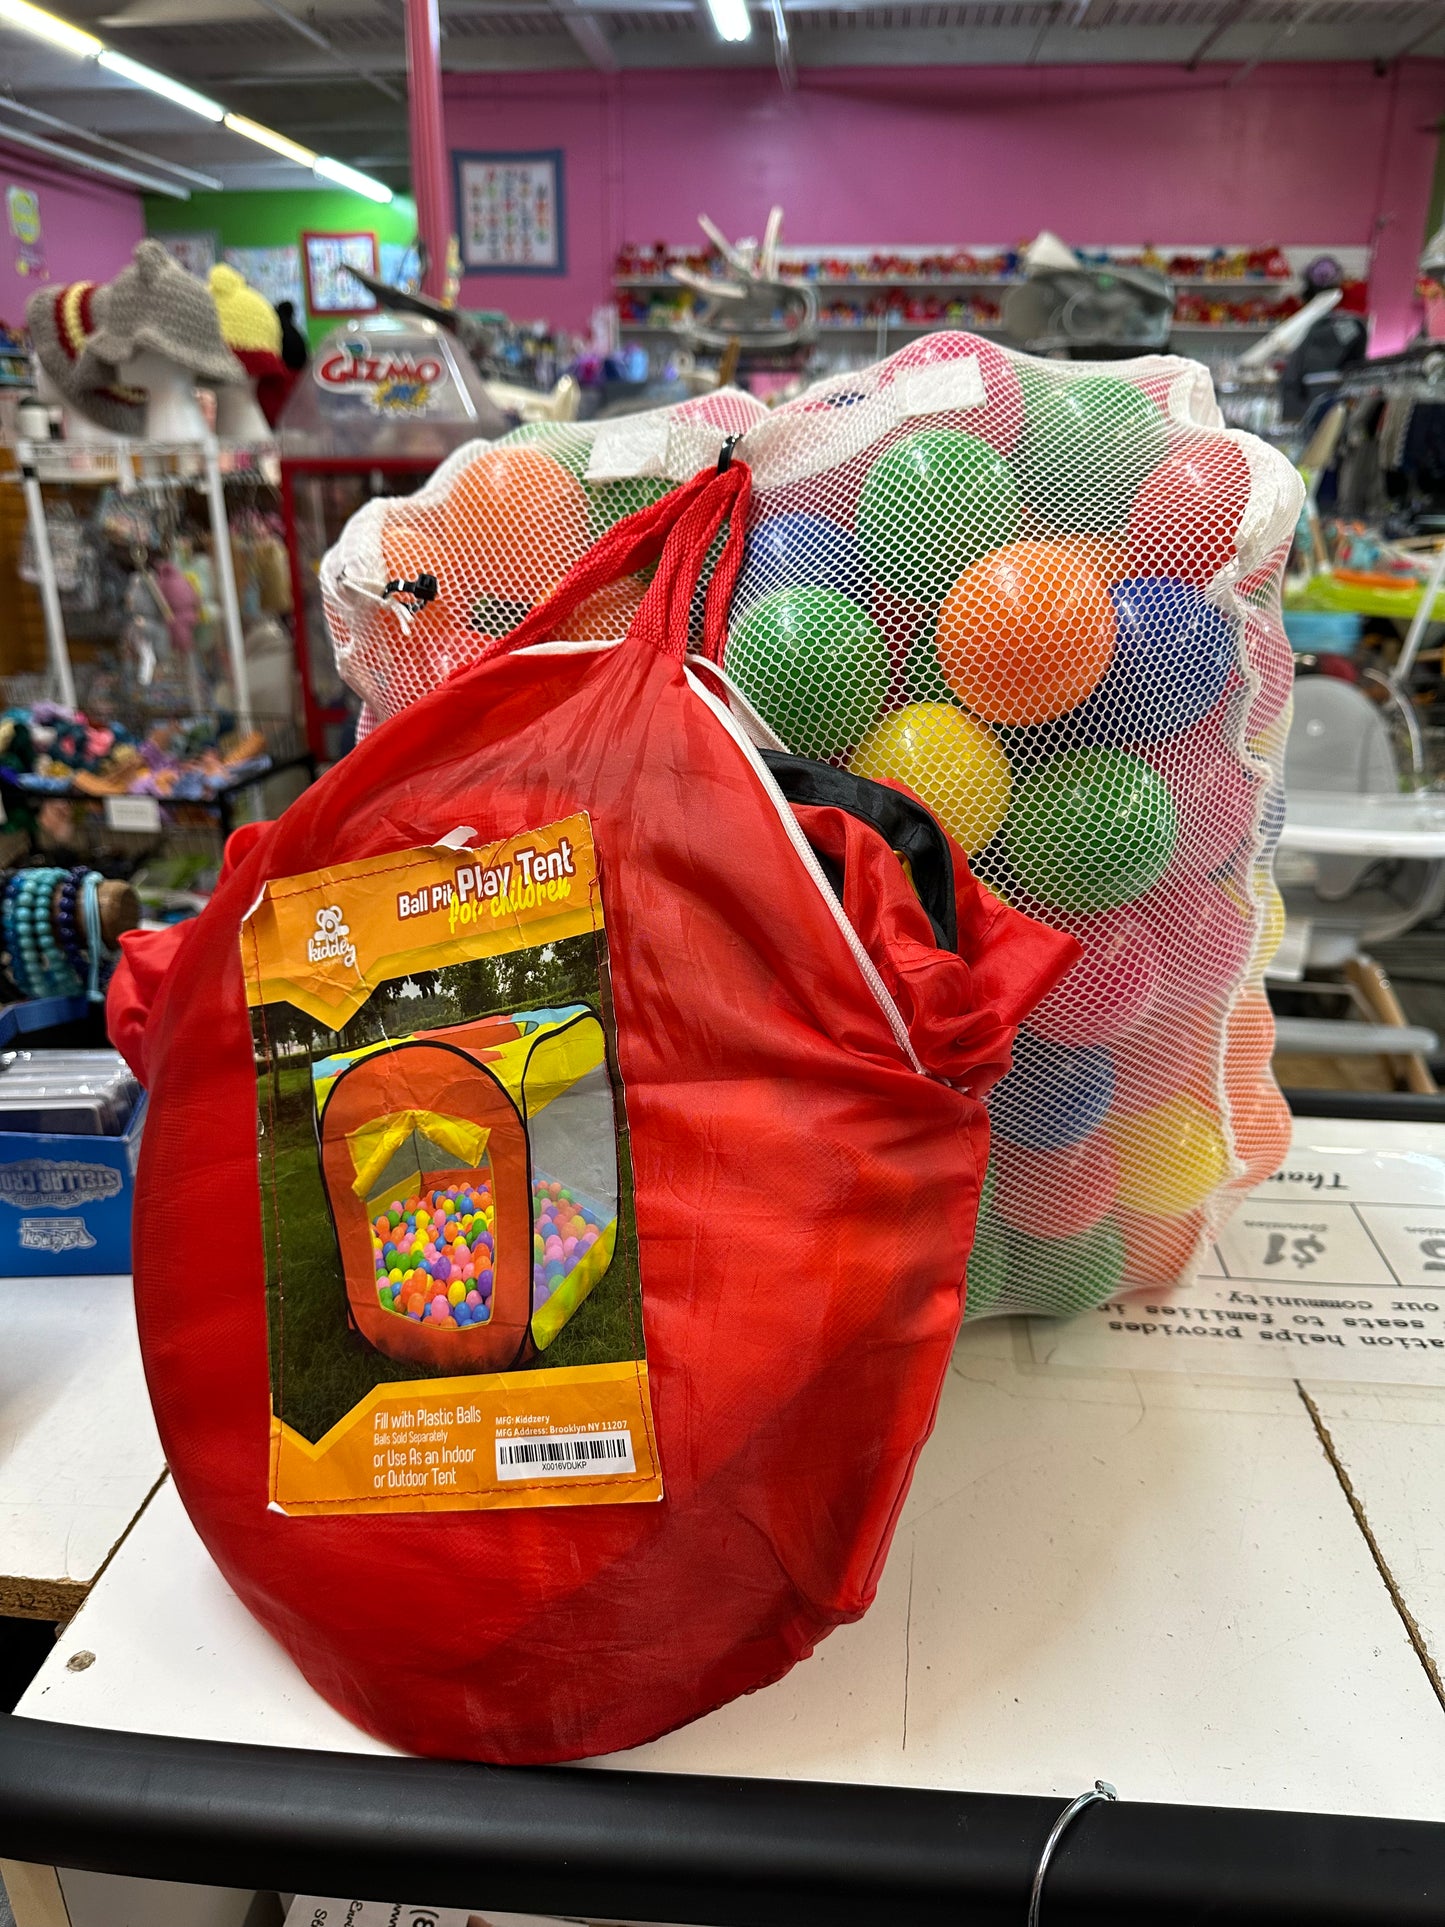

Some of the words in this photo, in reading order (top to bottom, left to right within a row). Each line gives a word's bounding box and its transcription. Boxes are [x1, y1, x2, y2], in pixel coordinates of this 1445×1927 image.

[398, 889, 428, 918] Ball
[432, 883, 453, 909] Pit
[456, 865, 512, 902] Play
[516, 840, 574, 886] Tent
[448, 891, 482, 935] for
[490, 872, 571, 918] children
[40, 1170, 119, 1192] STELLAR
[1262, 1232, 1327, 1270] $1
[1216, 1289, 1373, 1311] community.
[1391, 1300, 1440, 1312] our
[1145, 1304, 1275, 1326] families
[1292, 1314, 1325, 1327] to
[1343, 1316, 1425, 1329] seats
[1109, 1320, 1243, 1339] provides
[1259, 1328, 1346, 1347] helps
[374, 1411, 389, 1430] Fill
[391, 1410, 415, 1429] with
[417, 1407, 454, 1427] Plastic
[456, 1405, 482, 1424] Balls
[495, 1416, 514, 1425] MFG:
[515, 1415, 550, 1425] Kiddzery
[495, 1428, 513, 1437] MFG
[513, 1427, 548, 1437] Address:
[549, 1424, 587, 1435] Brooklyn
[587, 1423, 600, 1432] NY
[602, 1420, 628, 1430] 11207
[373, 1433, 391, 1446] Balls
[392, 1431, 408, 1445] Sold
[408, 1429, 449, 1444] Separately
[373, 1453, 386, 1468] or
[387, 1449, 407, 1467] Use
[409, 1447, 422, 1465] As
[424, 1451, 439, 1465] an
[442, 1445, 477, 1463] Indoor
[373, 1474, 386, 1489] or
[387, 1469, 429, 1488] Outdoor
[430, 1466, 457, 1486] Tent
